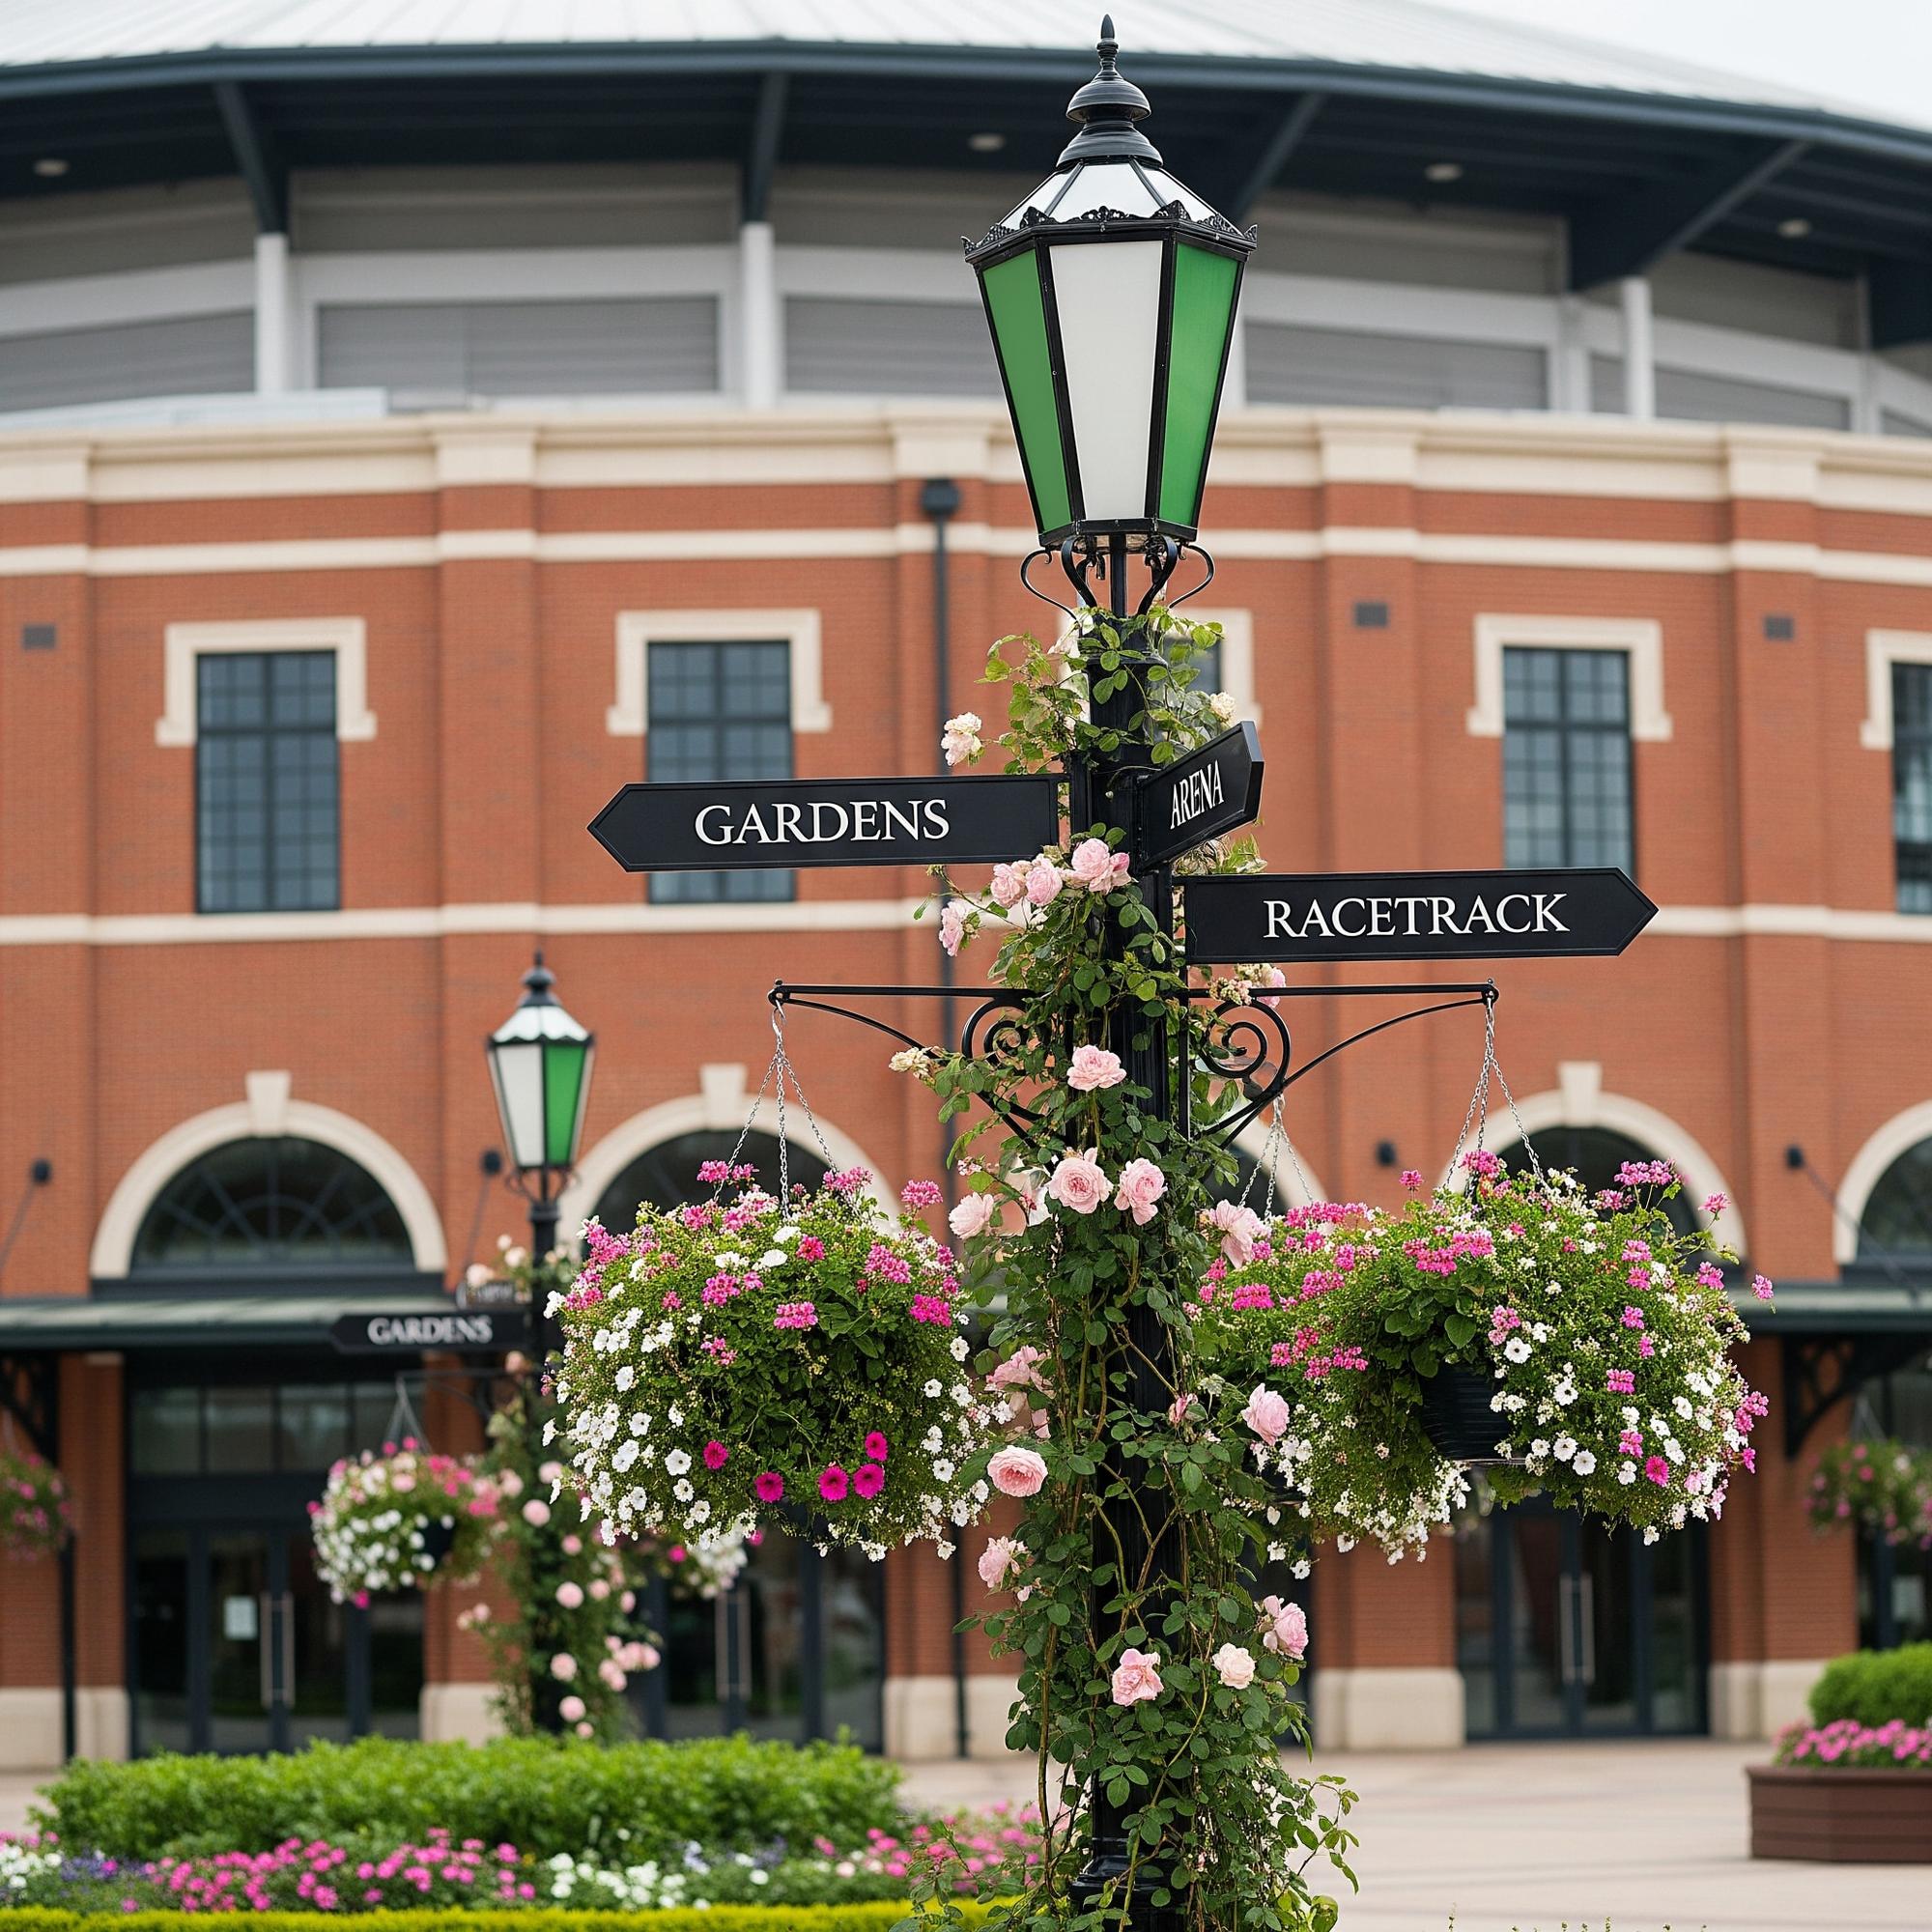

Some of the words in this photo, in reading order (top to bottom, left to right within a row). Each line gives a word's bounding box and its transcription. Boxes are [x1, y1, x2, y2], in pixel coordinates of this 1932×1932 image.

[1170, 759, 1225, 830] ARENA
[695, 799, 950, 845] GARDENS
[1263, 893, 1571, 938] RACETRACK
[367, 1315, 493, 1346] GARDENS
